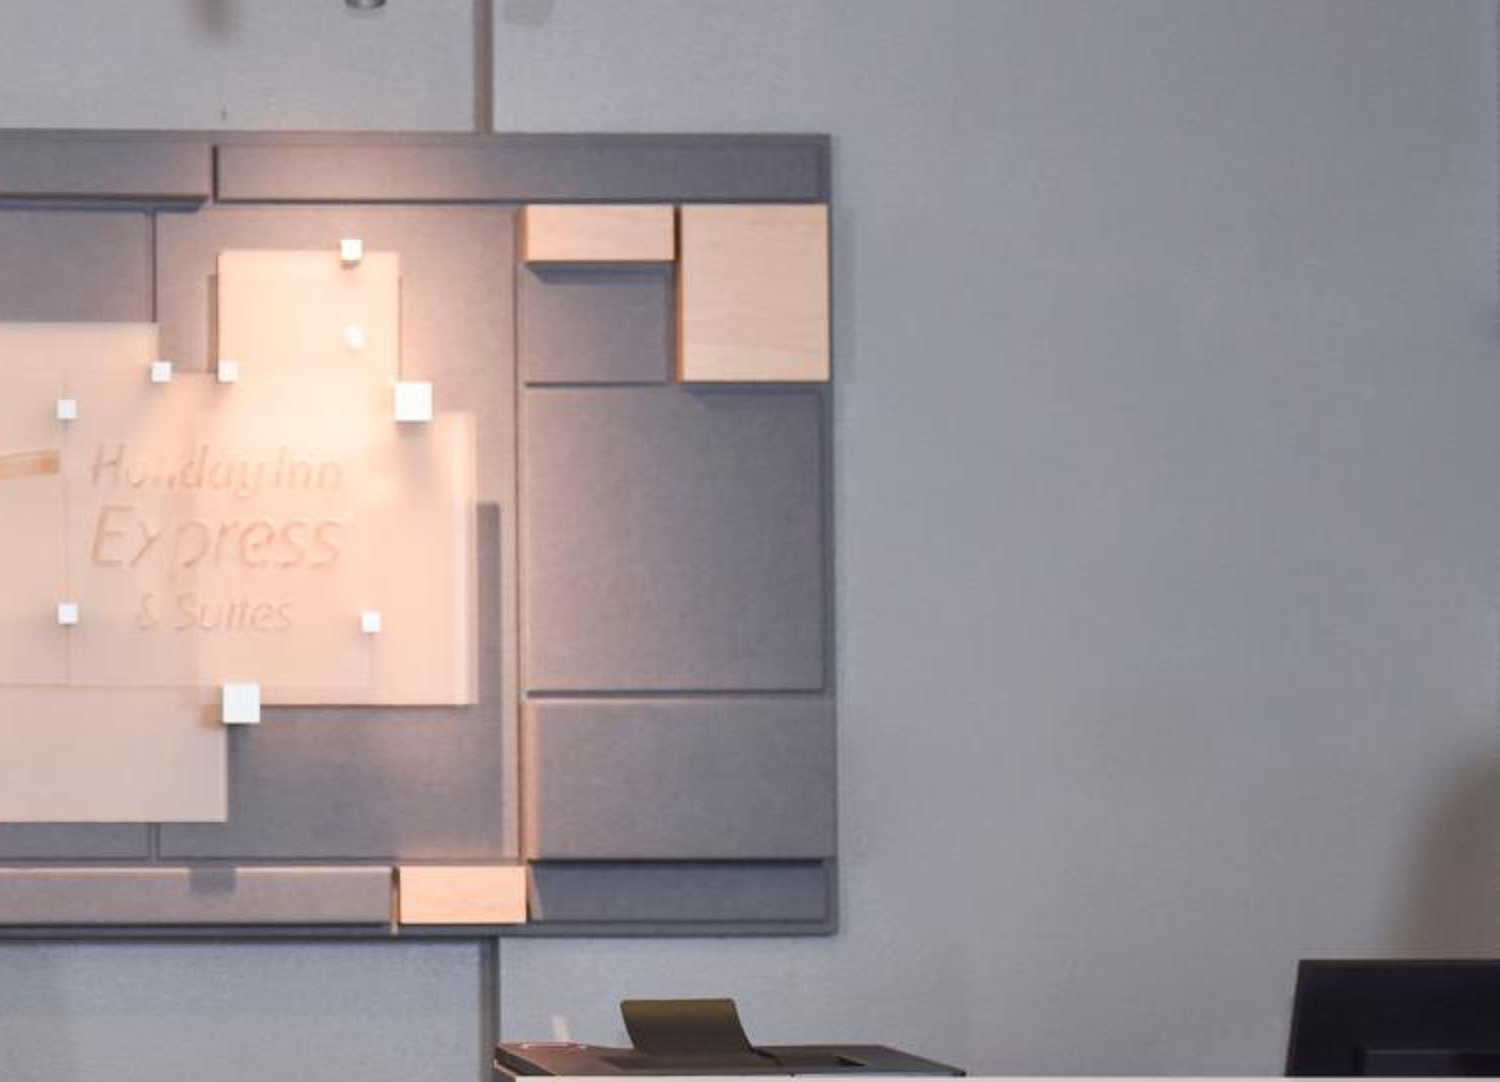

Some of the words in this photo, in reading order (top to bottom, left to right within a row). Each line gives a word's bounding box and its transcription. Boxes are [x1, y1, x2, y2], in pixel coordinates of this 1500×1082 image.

[90, 443, 267, 501] Hoday
[275, 445, 343, 490] Inn
[90, 504, 343, 585] Express
[173, 591, 294, 632] Suites
